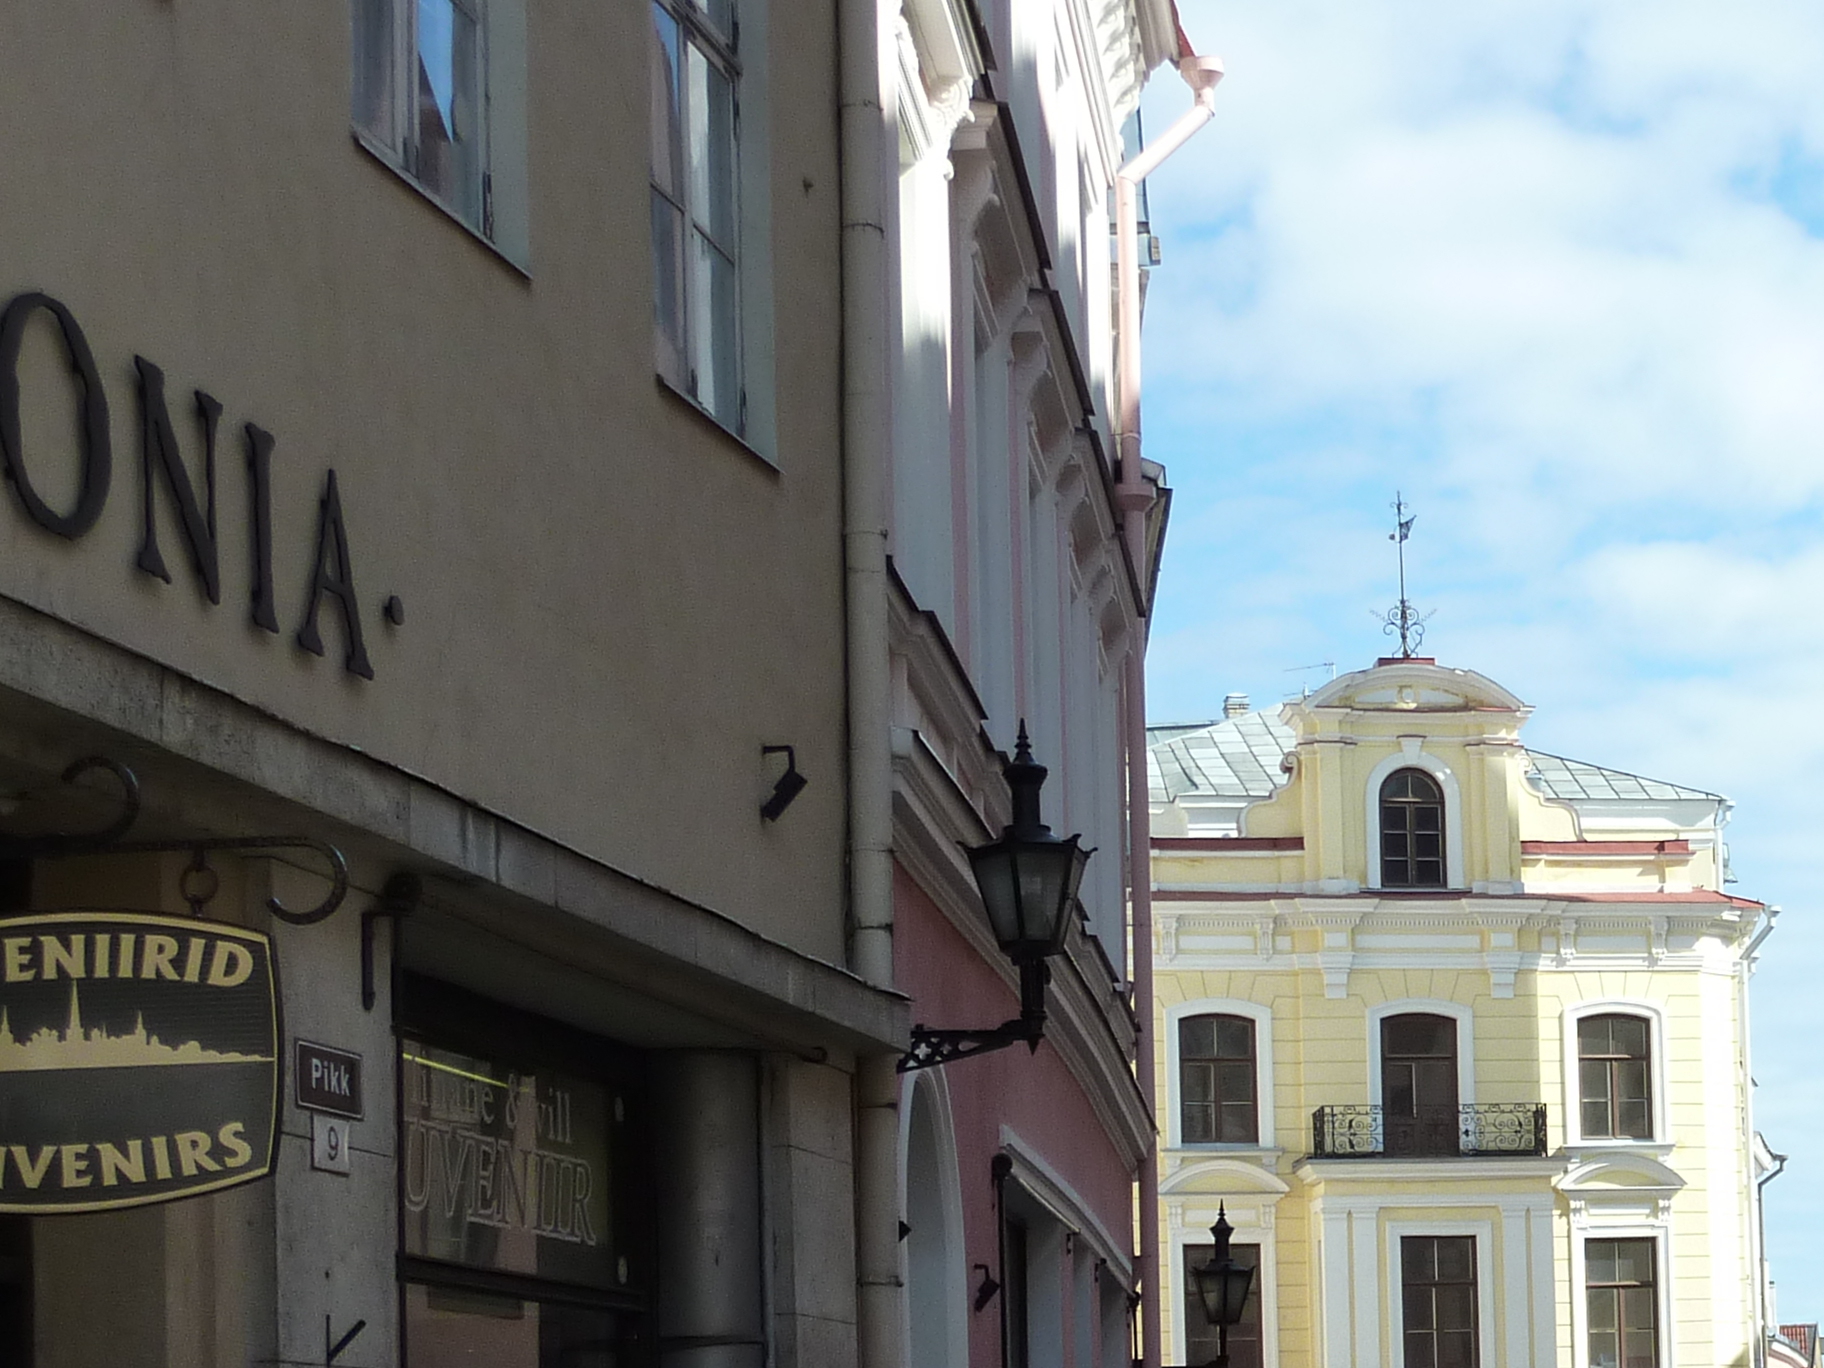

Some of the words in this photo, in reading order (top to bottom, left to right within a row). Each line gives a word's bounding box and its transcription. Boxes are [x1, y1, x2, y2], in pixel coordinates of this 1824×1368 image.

[3, 932, 255, 988] ENIIRID
[310, 1057, 352, 1098] Pikk
[0, 1121, 253, 1190] VENIRS
[326, 1135, 341, 1162] 9
